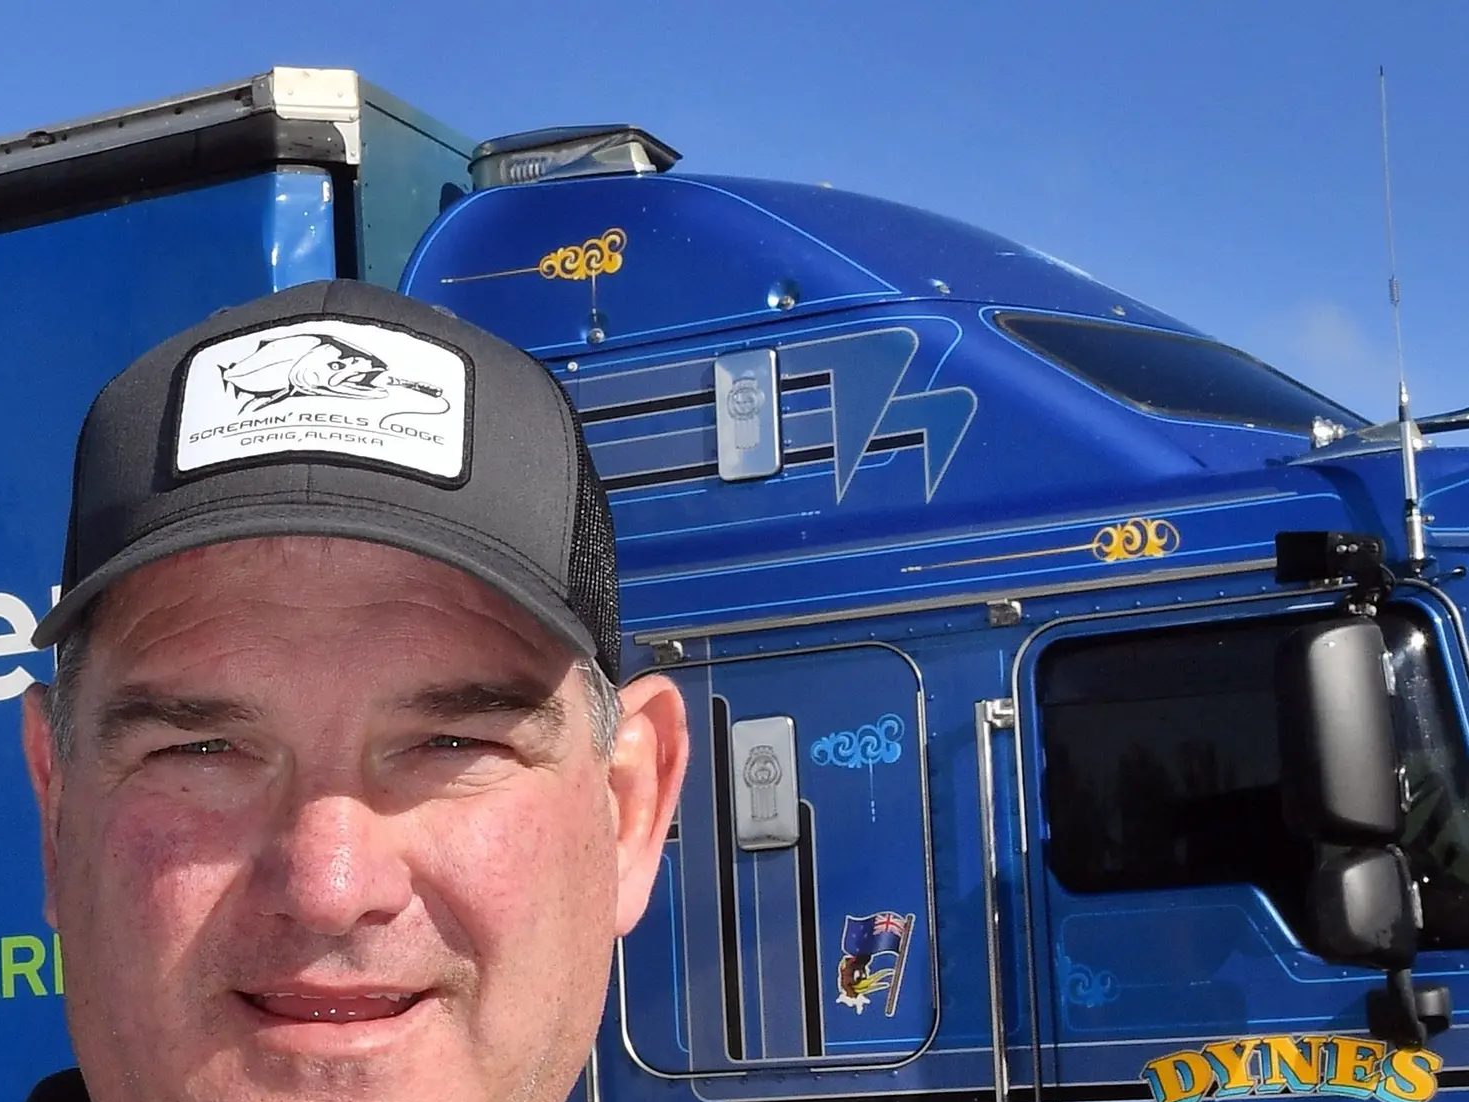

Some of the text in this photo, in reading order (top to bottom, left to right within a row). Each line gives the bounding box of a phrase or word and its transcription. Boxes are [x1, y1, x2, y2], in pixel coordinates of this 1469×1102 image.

[189, 412, 445, 446] SCREAMIN' REELS LODGE
